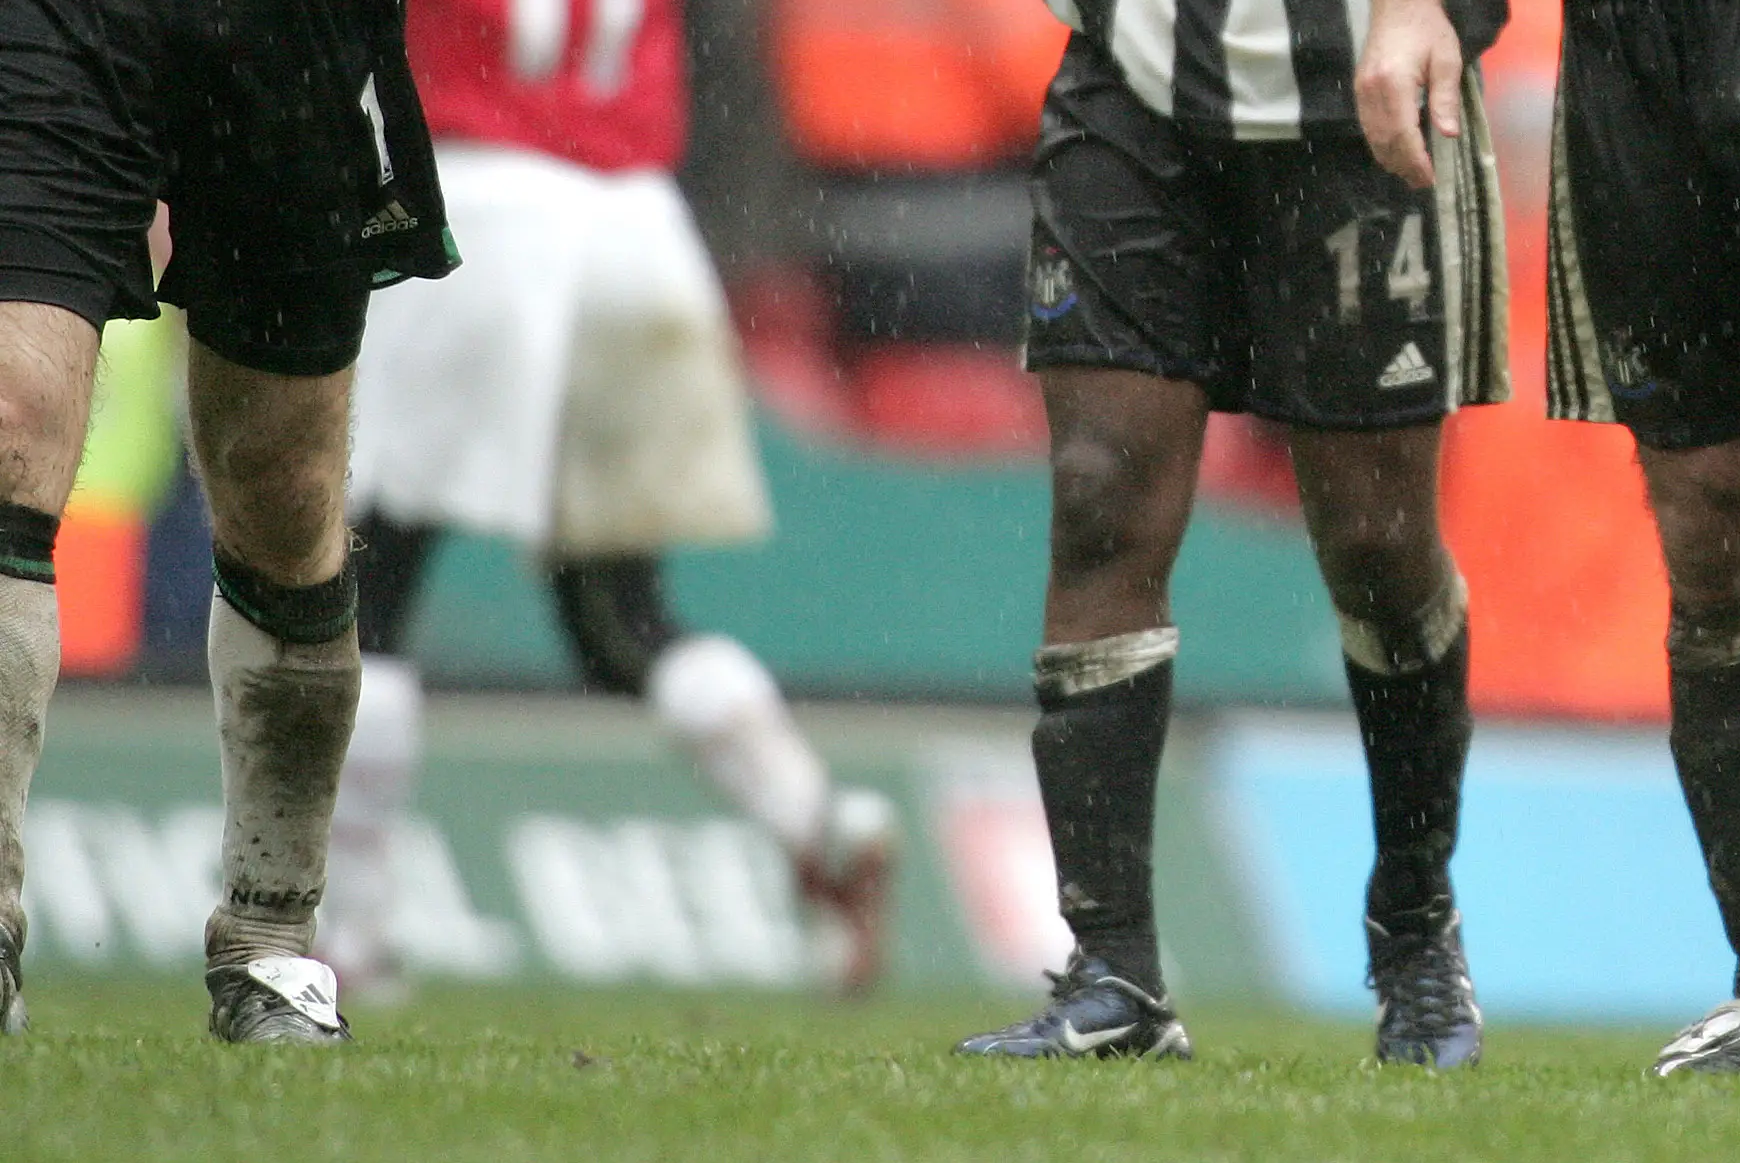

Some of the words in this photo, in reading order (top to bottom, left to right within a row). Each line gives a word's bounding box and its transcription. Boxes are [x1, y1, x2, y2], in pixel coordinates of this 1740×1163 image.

[359, 71, 395, 187] 1
[360, 216, 419, 239] adidas
[1323, 212, 1432, 325] 14
[230, 884, 320, 908] NUFC
